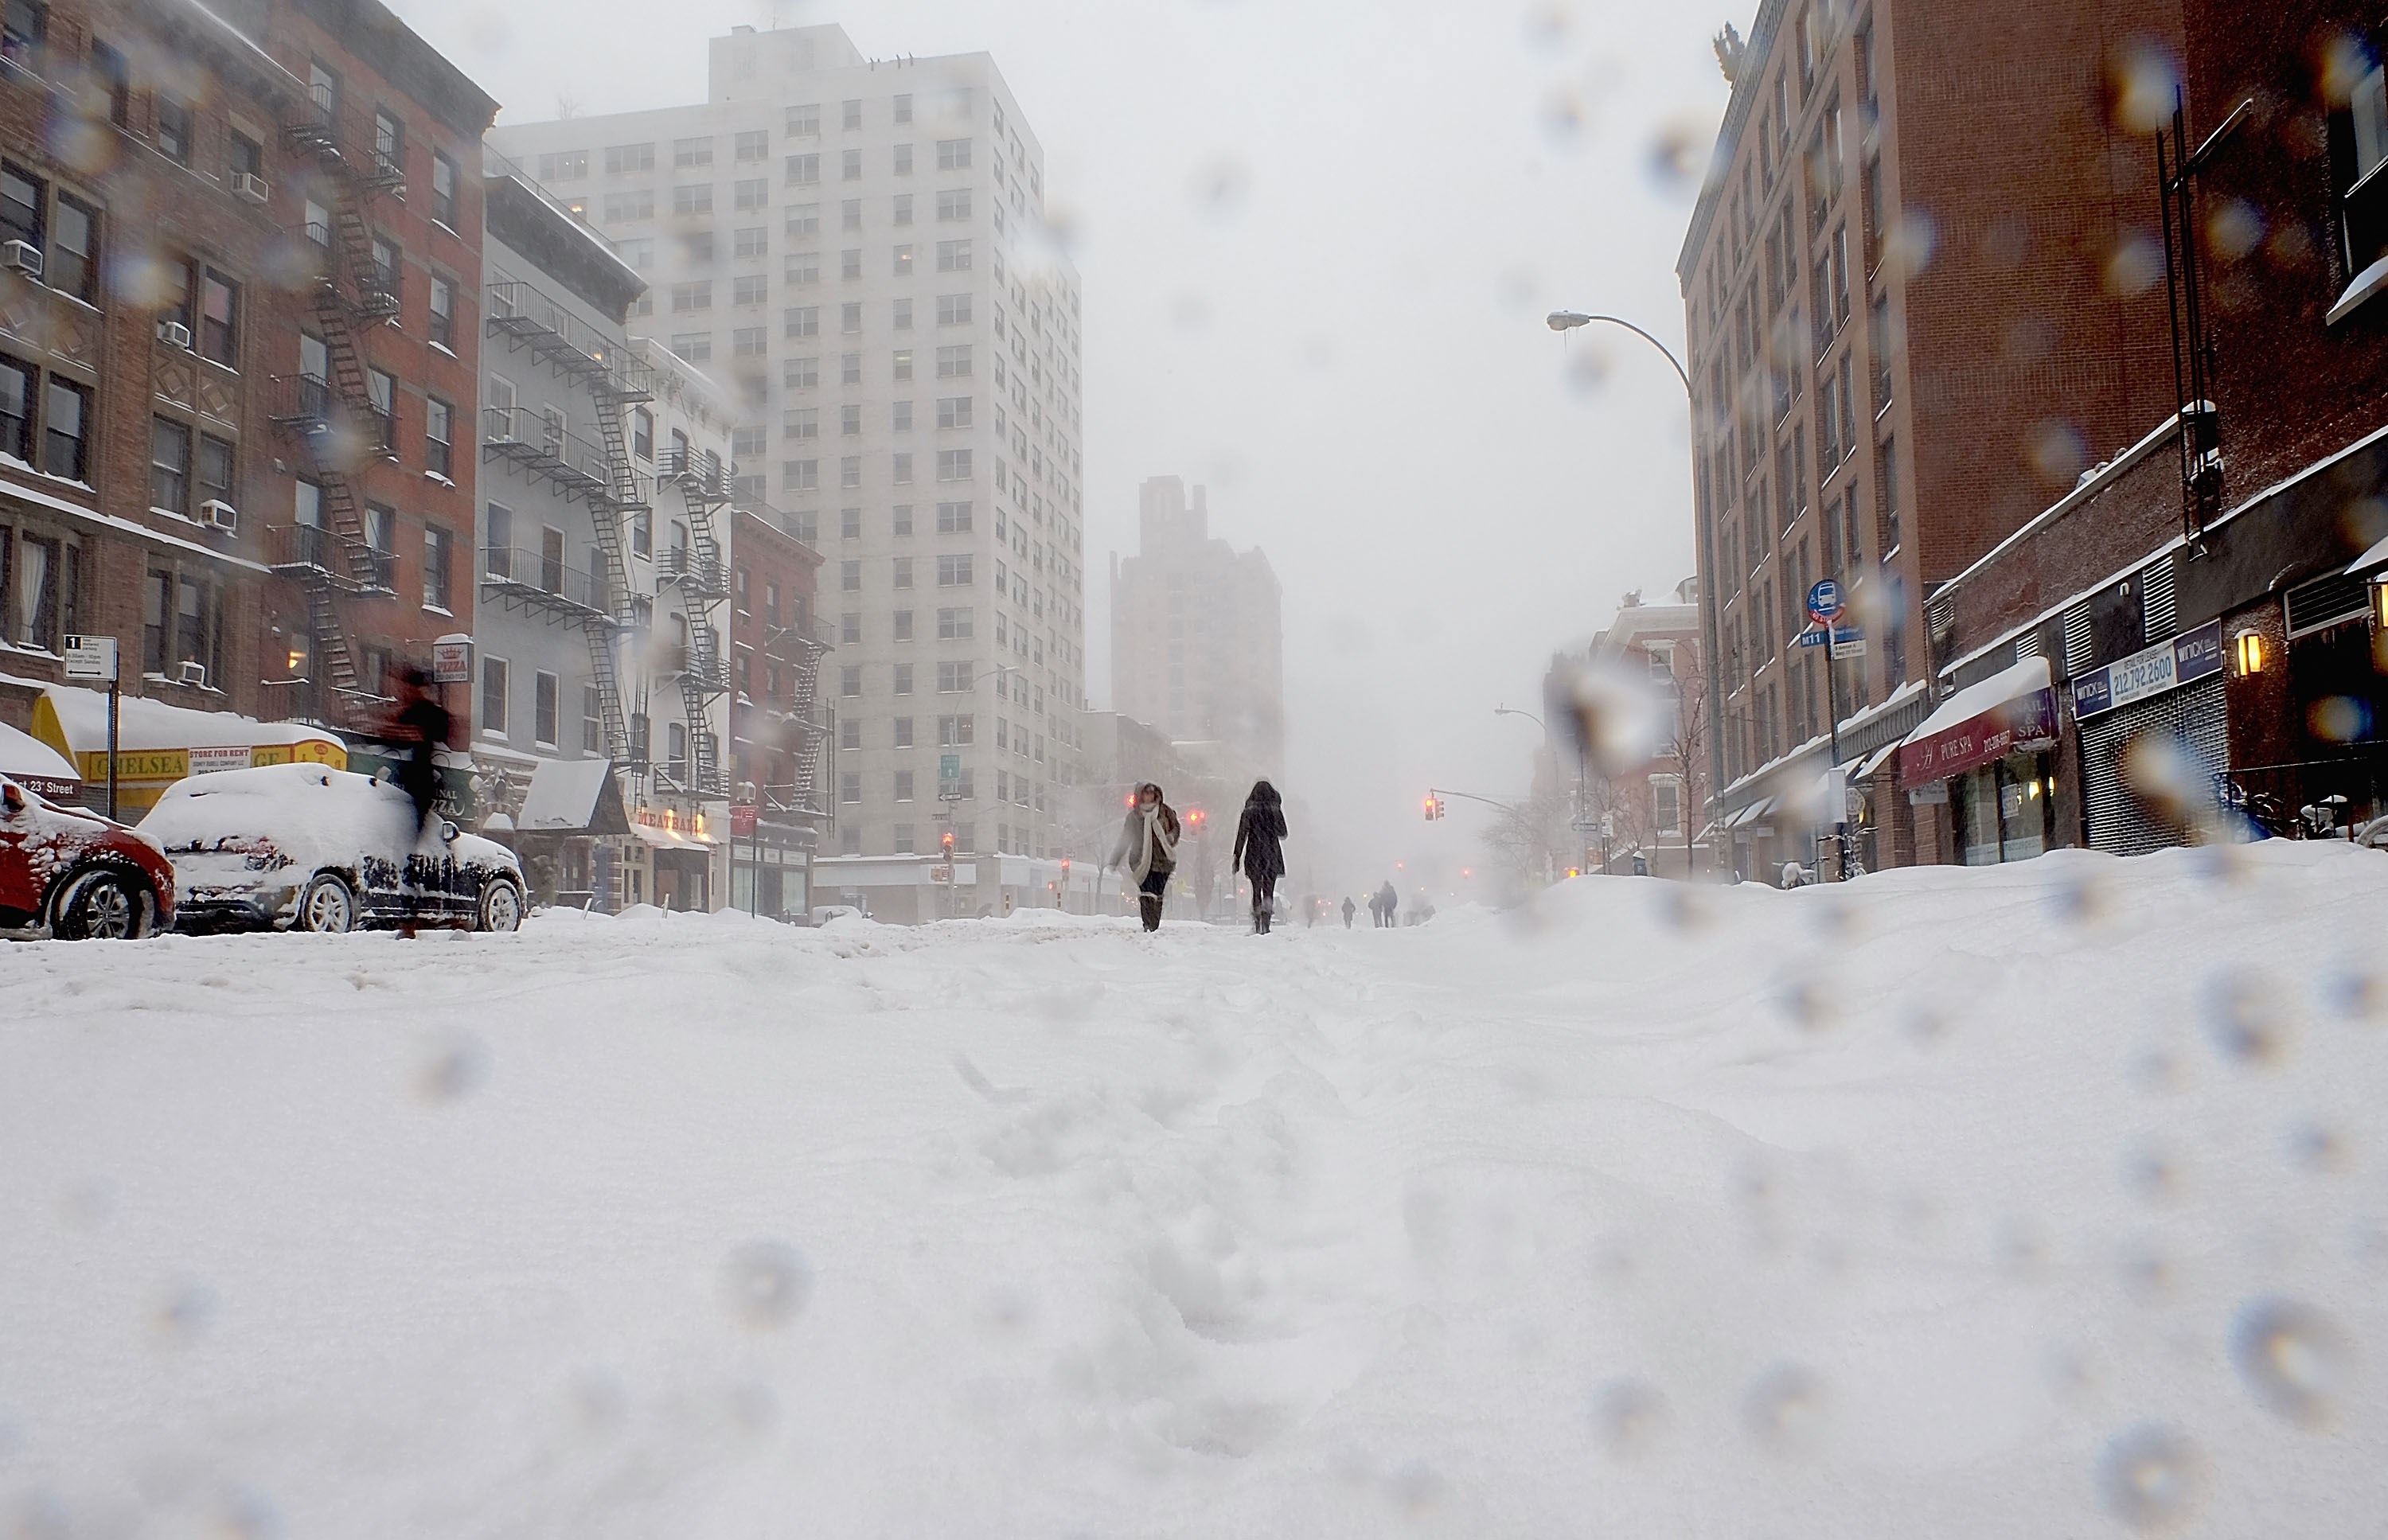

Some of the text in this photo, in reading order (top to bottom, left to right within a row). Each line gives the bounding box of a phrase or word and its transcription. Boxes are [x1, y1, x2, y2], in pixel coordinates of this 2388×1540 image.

[69, 637, 76, 648] 1
[1801, 633, 1820, 645] M11
[435, 661, 466, 673] PIZZA
[2113, 656, 2171, 696] 212.792.2600
[2018, 725, 2045, 738] SPA
[189, 750, 213, 758] STORE
[1941, 740, 1959, 761] PURE
[1960, 735, 1973, 754] SPA
[46, 782, 73, 794] Street
[638, 812, 701, 833] MEATBALL
